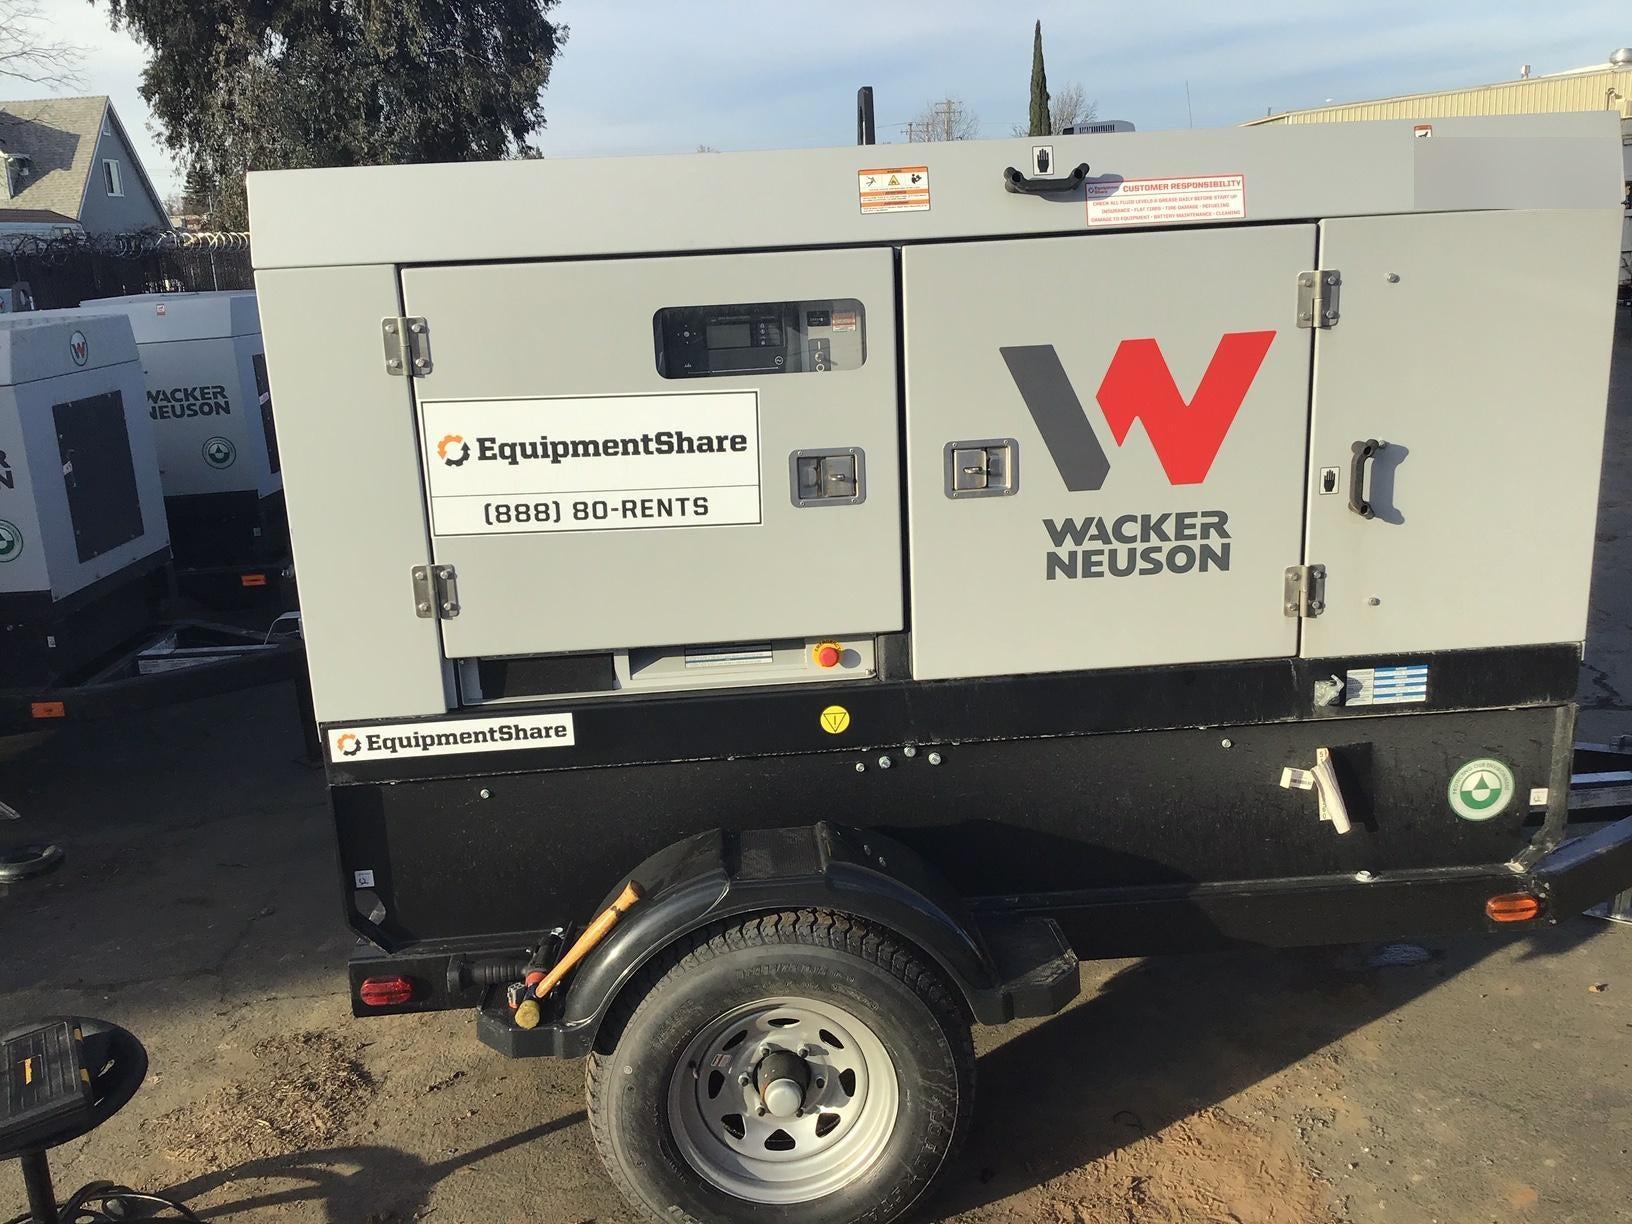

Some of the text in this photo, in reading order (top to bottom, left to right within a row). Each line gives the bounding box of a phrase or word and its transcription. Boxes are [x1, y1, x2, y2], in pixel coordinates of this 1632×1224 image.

[1122, 179, 1241, 193] CUSTOMER RESPONSIBILITY
[476, 431, 747, 465] EquipmentShare
[484, 496, 709, 525] (888) 80-RENTS
[1042, 510, 1232, 547] WACKER
[1046, 542, 1231, 580] NEUSON
[366, 724, 568, 753] EquipmentShare
